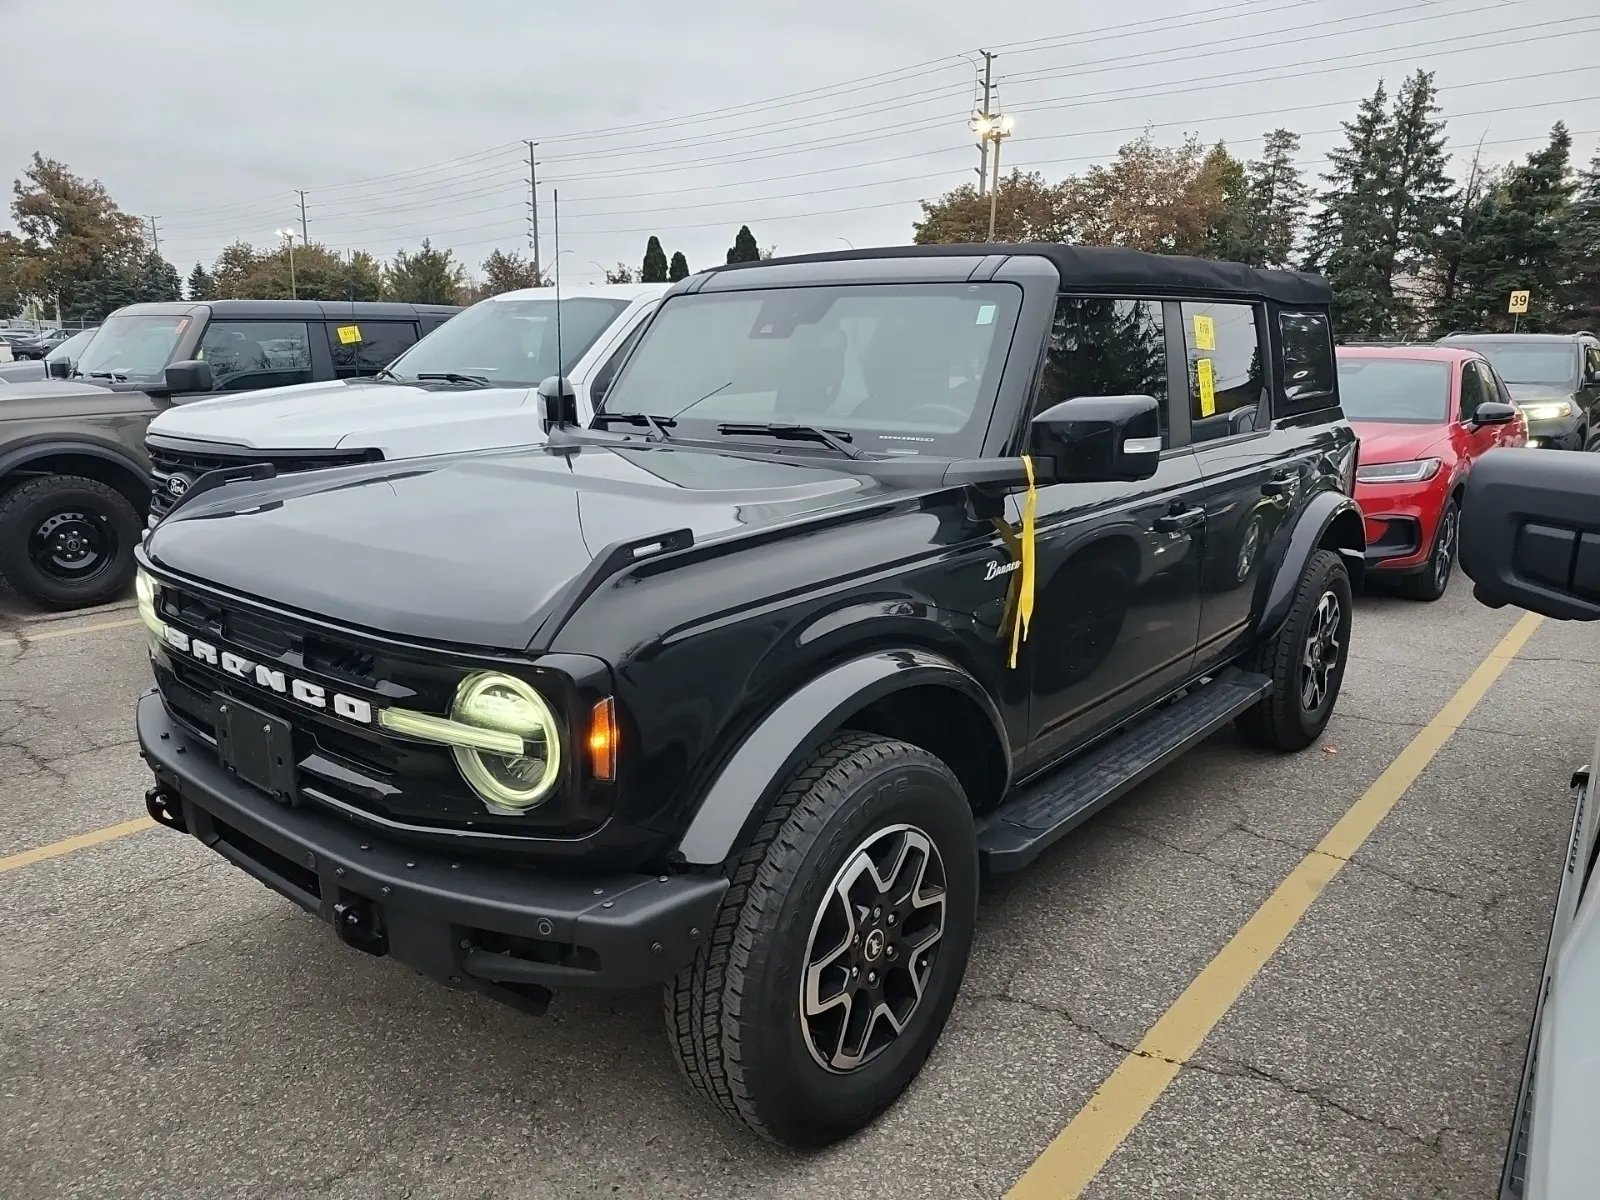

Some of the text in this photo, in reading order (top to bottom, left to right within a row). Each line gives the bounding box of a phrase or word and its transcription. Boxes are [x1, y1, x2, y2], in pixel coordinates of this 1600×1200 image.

[1511, 294, 1527, 307] 39
[170, 478, 185, 494] Ford
[983, 560, 1022, 581] Bronco
[164, 624, 372, 724] BRONCO
